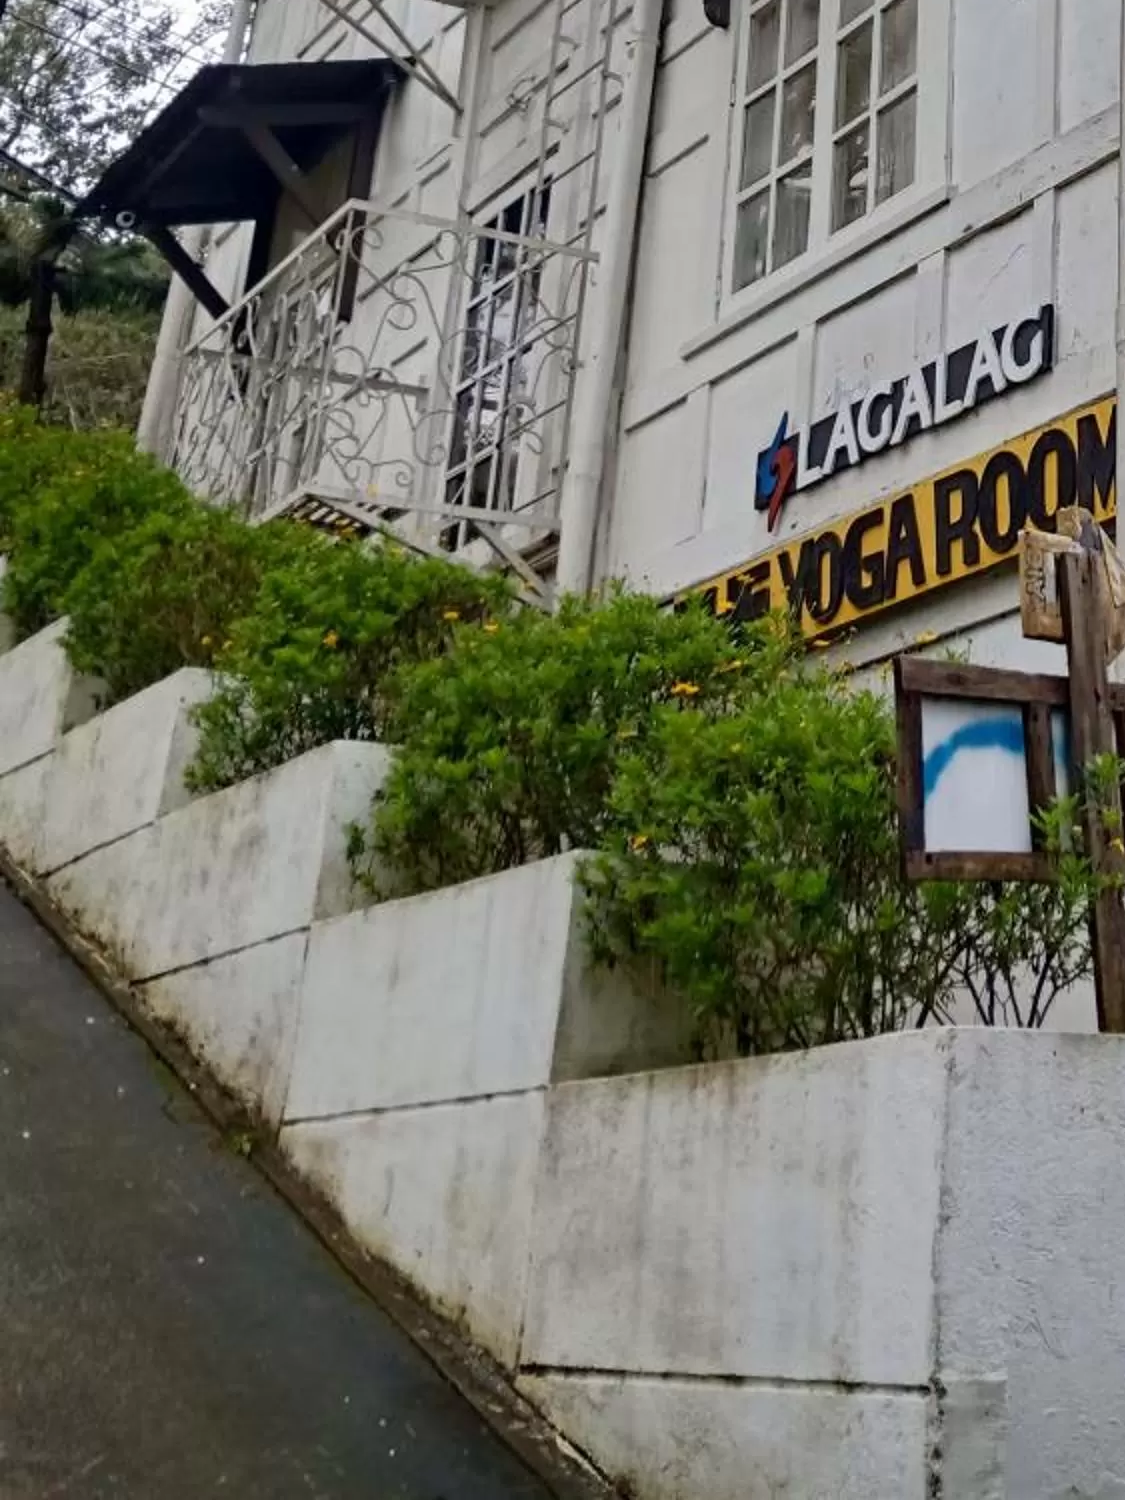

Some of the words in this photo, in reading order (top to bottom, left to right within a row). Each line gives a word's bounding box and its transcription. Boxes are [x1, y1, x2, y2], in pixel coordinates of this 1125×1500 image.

[796, 303, 1045, 490] LAGALAG
[777, 496, 927, 630] YOGA
[933, 404, 1117, 577] ROOM
